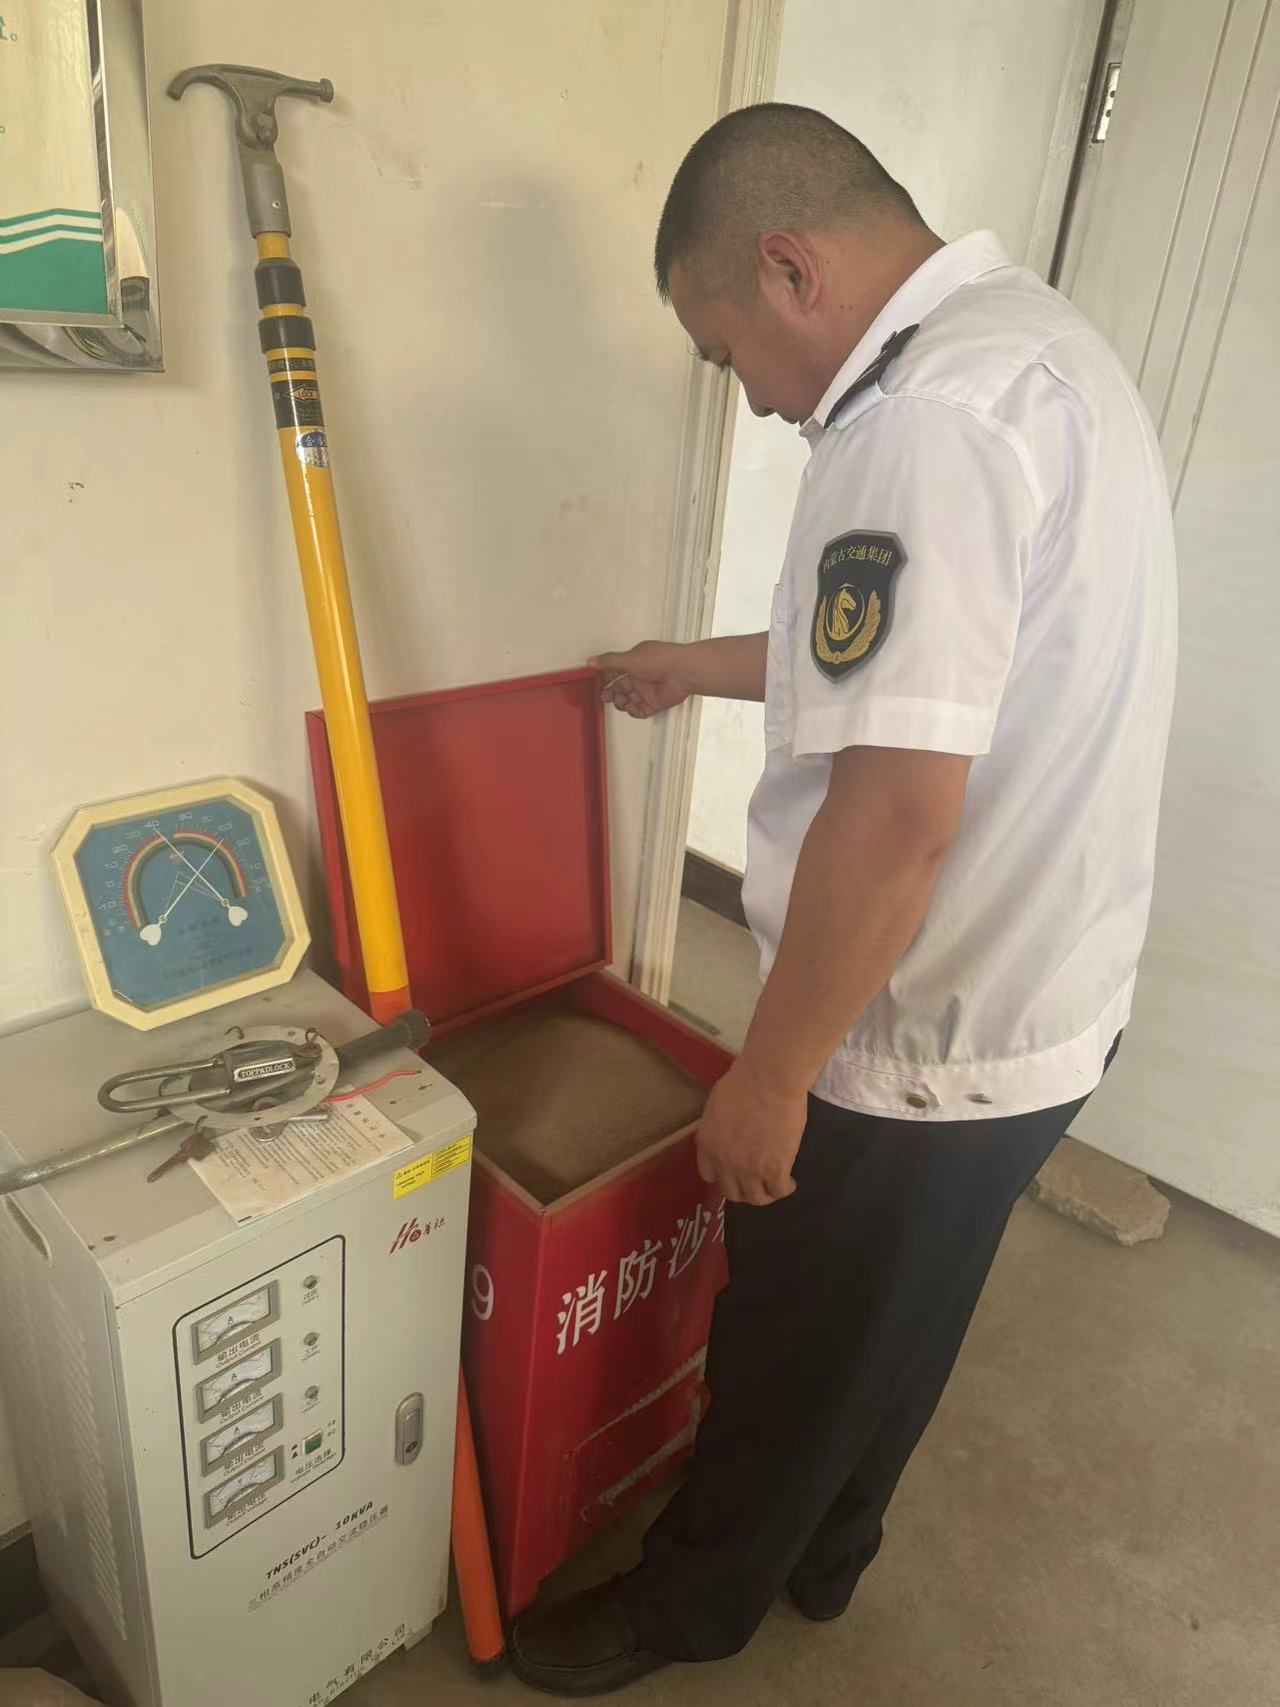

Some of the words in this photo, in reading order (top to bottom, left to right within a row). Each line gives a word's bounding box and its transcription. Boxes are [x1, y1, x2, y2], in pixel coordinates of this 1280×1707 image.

[823, 545, 892, 573] 内蒙古交通集团
[240, 1062, 291, 1078] TOPPADLOCK
[471, 1264, 494, 1321] 9
[335, 1500, 374, 1531] 10KVA
